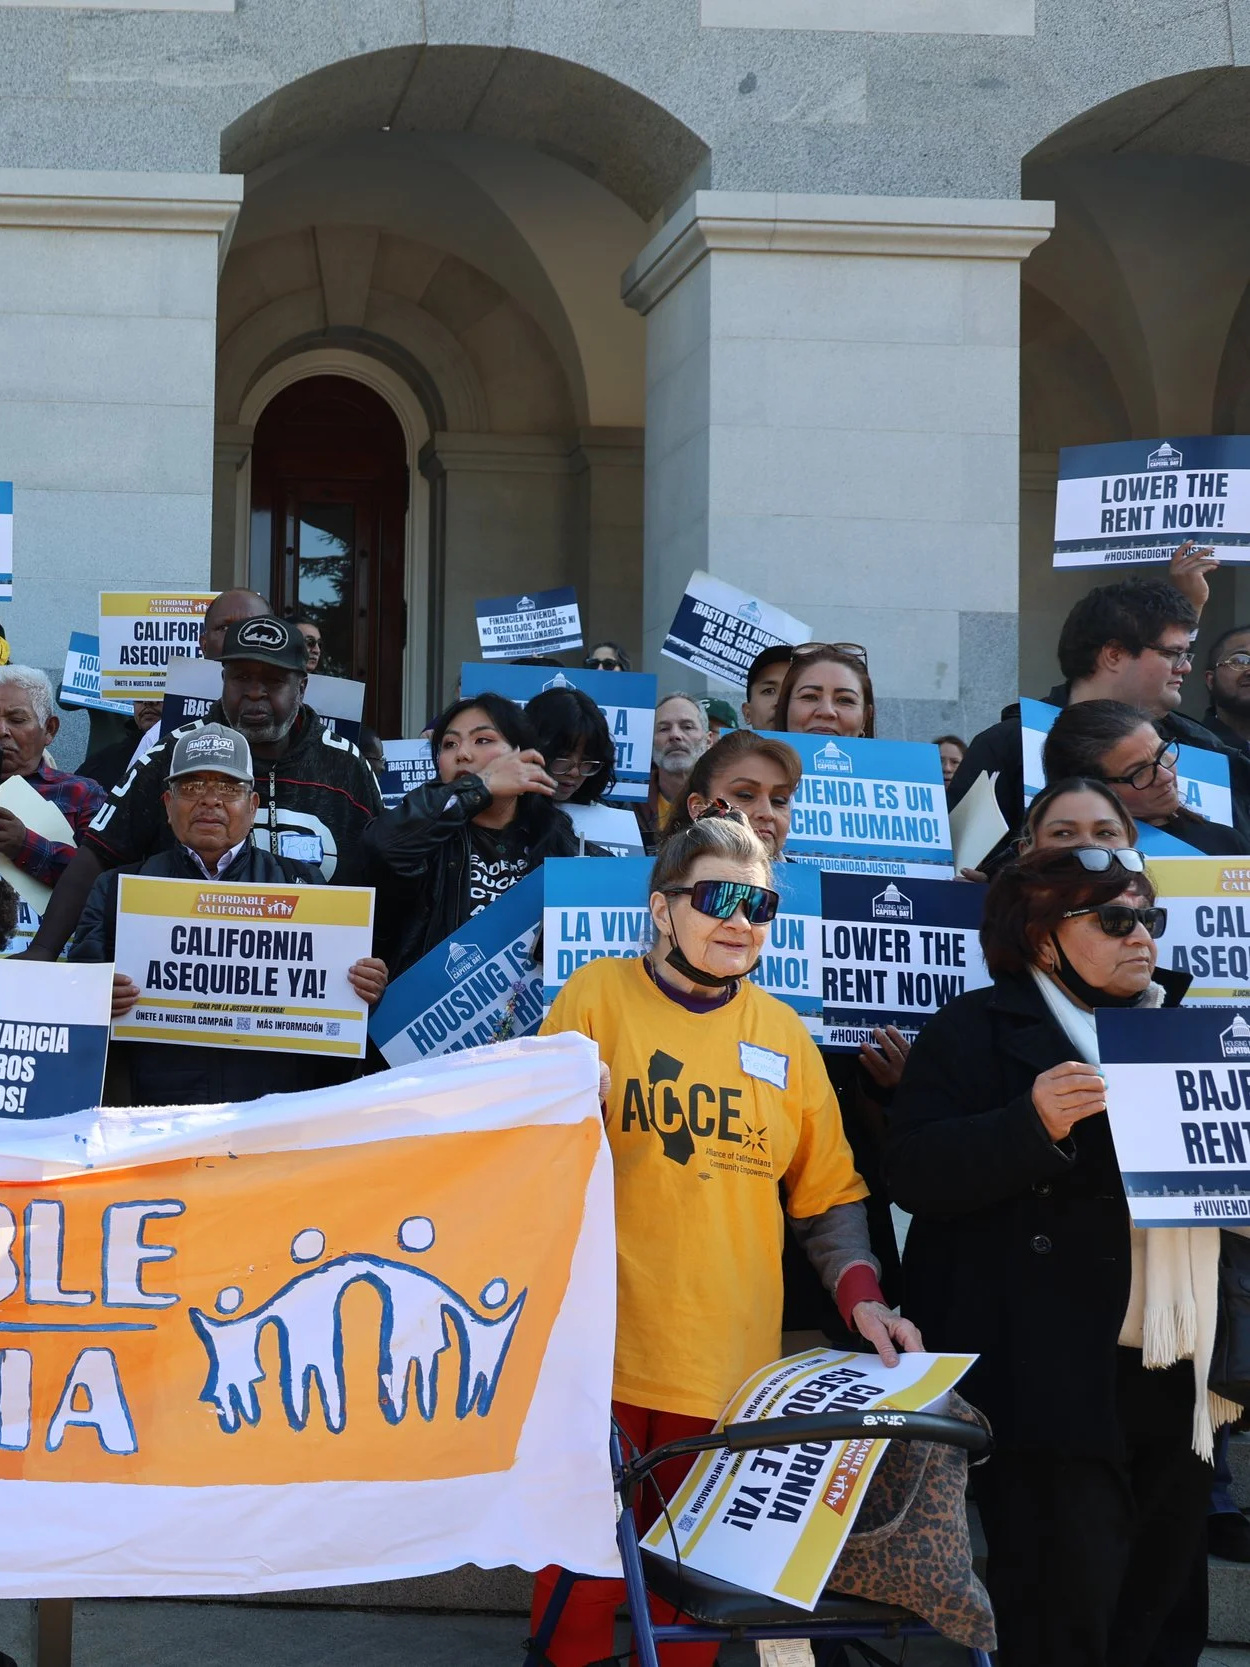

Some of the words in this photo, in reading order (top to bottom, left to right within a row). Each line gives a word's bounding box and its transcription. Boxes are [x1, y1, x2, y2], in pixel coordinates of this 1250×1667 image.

[1101, 474, 1178, 504] LOWER
[1186, 473, 1229, 497] THE
[1101, 506, 1155, 533] RENT
[1162, 503, 1225, 529] NOW!
[482, 627, 491, 635] NO
[568, 615, 576, 624] NI
[489, 613, 525, 625] FINANCIEN
[525, 609, 557, 621] VIVIENDA
[692, 601, 727, 625] ¡BASTA
[725, 616, 740, 631] DE
[739, 622, 752, 637] LA
[497, 627, 564, 643] MULTIMILLONARIOS
[702, 621, 716, 635] DE
[716, 627, 735, 644] LOS
[613, 709, 628, 736] A
[189, 740, 211, 750] ANDY
[388, 761, 413, 771] ¡BASTA
[415, 761, 424, 770] DE
[426, 761, 435, 769] LA
[401, 772, 411, 781] DE
[412, 771, 426, 780] LOS
[873, 783, 899, 810] ES
[905, 786, 934, 812] UN
[1186, 781, 1202, 807] A
[841, 813, 941, 844] HUMANO!
[197, 904, 263, 917] CALIFORNIA
[199, 893, 267, 906] AFFORDABLE
[170, 925, 313, 962] CALIFORNIA
[561, 912, 592, 942] LA
[771, 919, 805, 950] UN
[822, 925, 911, 963] LOWER
[920, 931, 966, 968] THE
[146, 960, 278, 997] ASEQUIBLE
[288, 967, 327, 999] YA!
[452, 964, 474, 979] CAPITOL
[471, 955, 482, 966] DAY
[406, 962, 512, 1056] HOUSING
[505, 940, 537, 978] IS
[822, 967, 888, 1004] RENT
[135, 1010, 157, 1021] ÚNETE
[158, 1013, 164, 1021] A
[166, 1014, 196, 1024] NUESTRA
[198, 1015, 233, 1027] CAMPAÑA
[256, 1018, 273, 1030] MÁS
[275, 1020, 324, 1033] INFORMACIÓN
[229, 1004, 250, 1012] JUSTICIA
[622, 1078, 743, 1143] ACCE
[706, 1148, 726, 1159] Alliance
[727, 1151, 735, 1160] of
[735, 1153, 771, 1168] Californians
[710, 1160, 739, 1174] Community
[742, 1386, 772, 1419] CAMPAÑA
[690, 1462, 725, 1514] INFORMACIÓN
[722, 1485, 772, 1531] YA!
